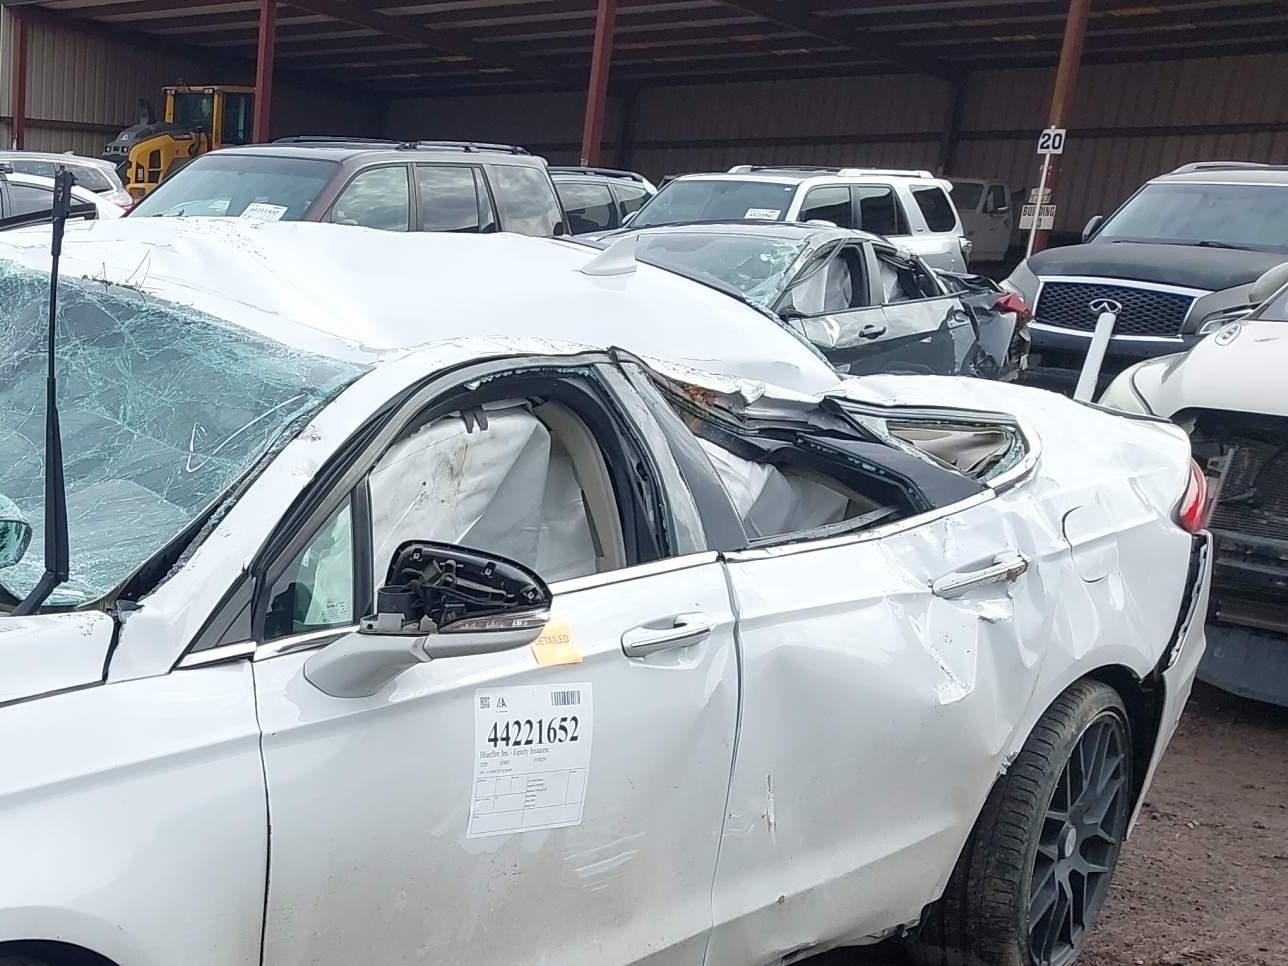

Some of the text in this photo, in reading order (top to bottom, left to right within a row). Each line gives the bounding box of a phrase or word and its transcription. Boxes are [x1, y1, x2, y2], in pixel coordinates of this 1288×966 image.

[1039, 133, 1063, 150] 20
[1022, 206, 1055, 217] BUIDING
[487, 715, 579, 748] 44221652
